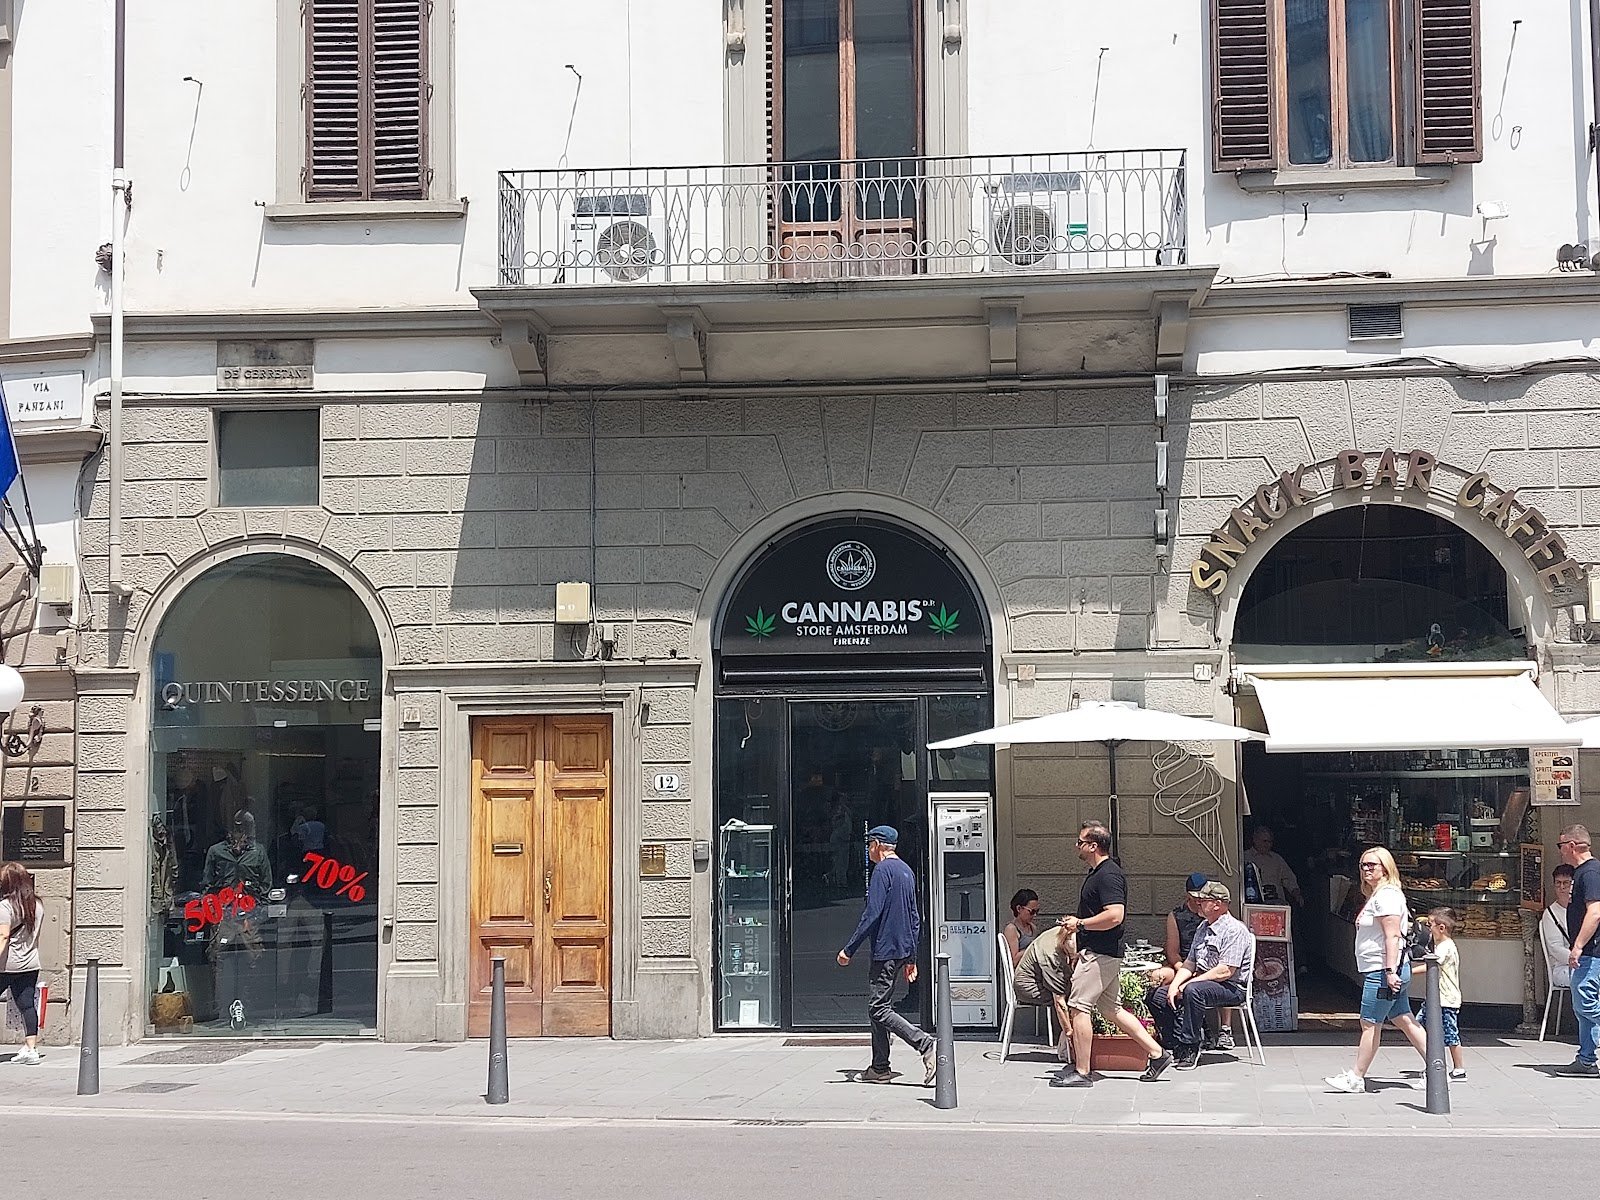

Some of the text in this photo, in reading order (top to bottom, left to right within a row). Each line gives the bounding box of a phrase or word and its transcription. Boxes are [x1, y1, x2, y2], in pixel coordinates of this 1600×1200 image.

[244, 369, 308, 379] CERRETANI
[33, 382, 50, 393] VIA
[18, 400, 64, 413] PANZANI
[1190, 464, 1319, 596] SNACK
[1337, 447, 1436, 493] BAR
[781, 600, 923, 624] CANNABIS
[796, 624, 908, 636] STORE AMSTERDAM
[161, 680, 370, 706] QUINTESSENCE
[659, 775, 675, 789] 12
[301, 852, 368, 902] 70%
[184, 881, 256, 932] 50%
[966, 925, 987, 935] h24
[744, 927, 754, 993] CANABIS
